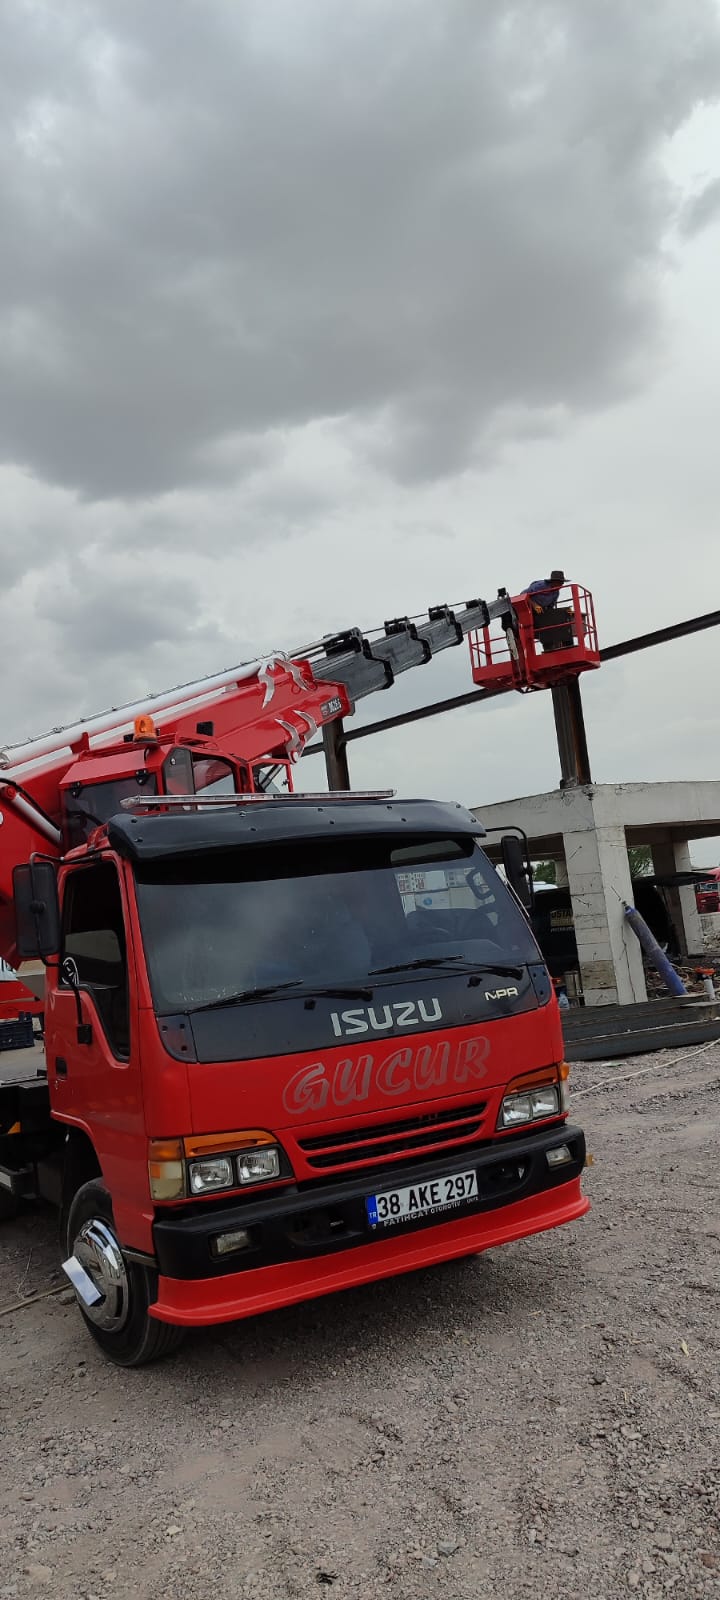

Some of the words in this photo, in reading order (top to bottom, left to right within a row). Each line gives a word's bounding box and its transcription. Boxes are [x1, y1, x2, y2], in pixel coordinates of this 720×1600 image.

[485, 987, 518, 1000] NPR
[330, 998, 442, 1037] ISUZU
[282, 1036, 491, 1114] GUCUR
[377, 1194, 401, 1218] 38
[408, 1182, 441, 1211] AKE
[444, 1173, 475, 1201] 297
